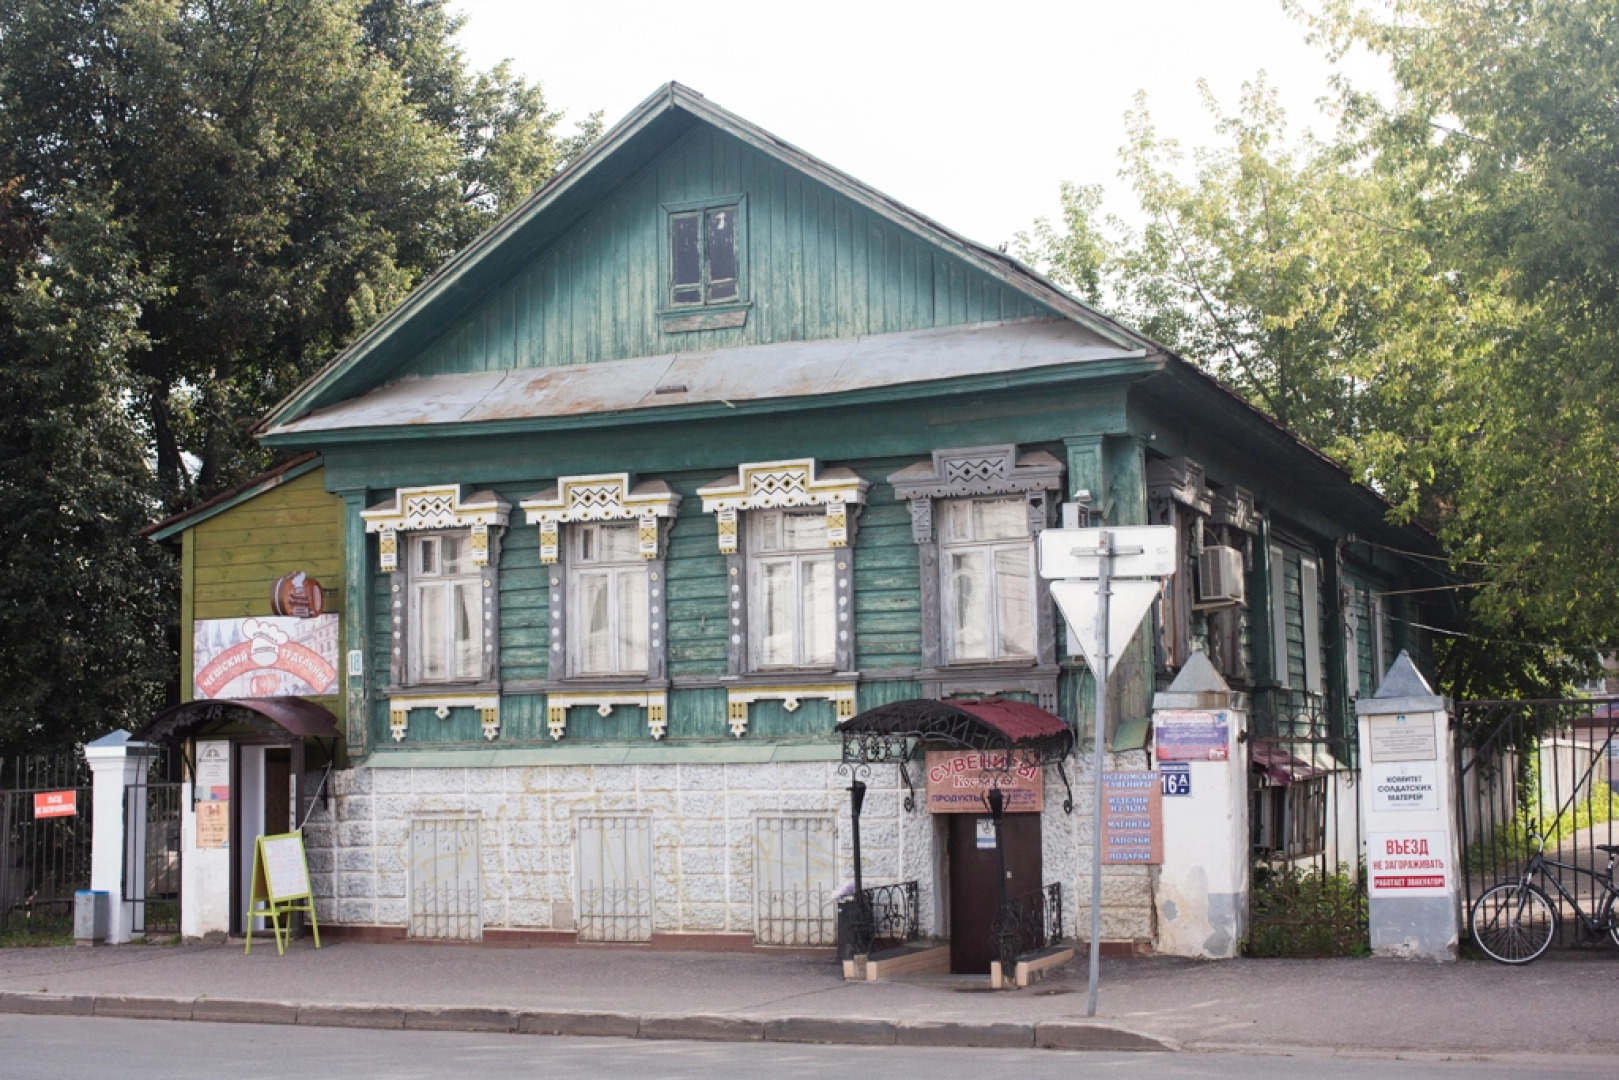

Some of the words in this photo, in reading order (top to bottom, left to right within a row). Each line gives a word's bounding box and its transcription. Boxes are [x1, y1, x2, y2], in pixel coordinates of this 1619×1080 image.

[351, 653, 361, 672] 18
[930, 754, 1038, 781] СУВЕНИЫ
[1386, 775, 1422, 783] КОМИТЕТ
[1377, 784, 1432, 793] СОЛДАТСКИХ
[1388, 792, 1423, 801] МАТЕРЕЙ
[1107, 821, 1151, 829] МАГНИТЫ
[1109, 837, 1151, 845] ТАПОЧКИ
[1386, 838, 1429, 856] ВЪЕЗД
[1109, 853, 1151, 861] ПОДАРКИ
[1373, 860, 1383, 870] НЕ
[1385, 859, 1444, 870] ЗАГОРАЖИВАТЬ
[1374, 878, 1404, 887] РАБОТАЕТ
